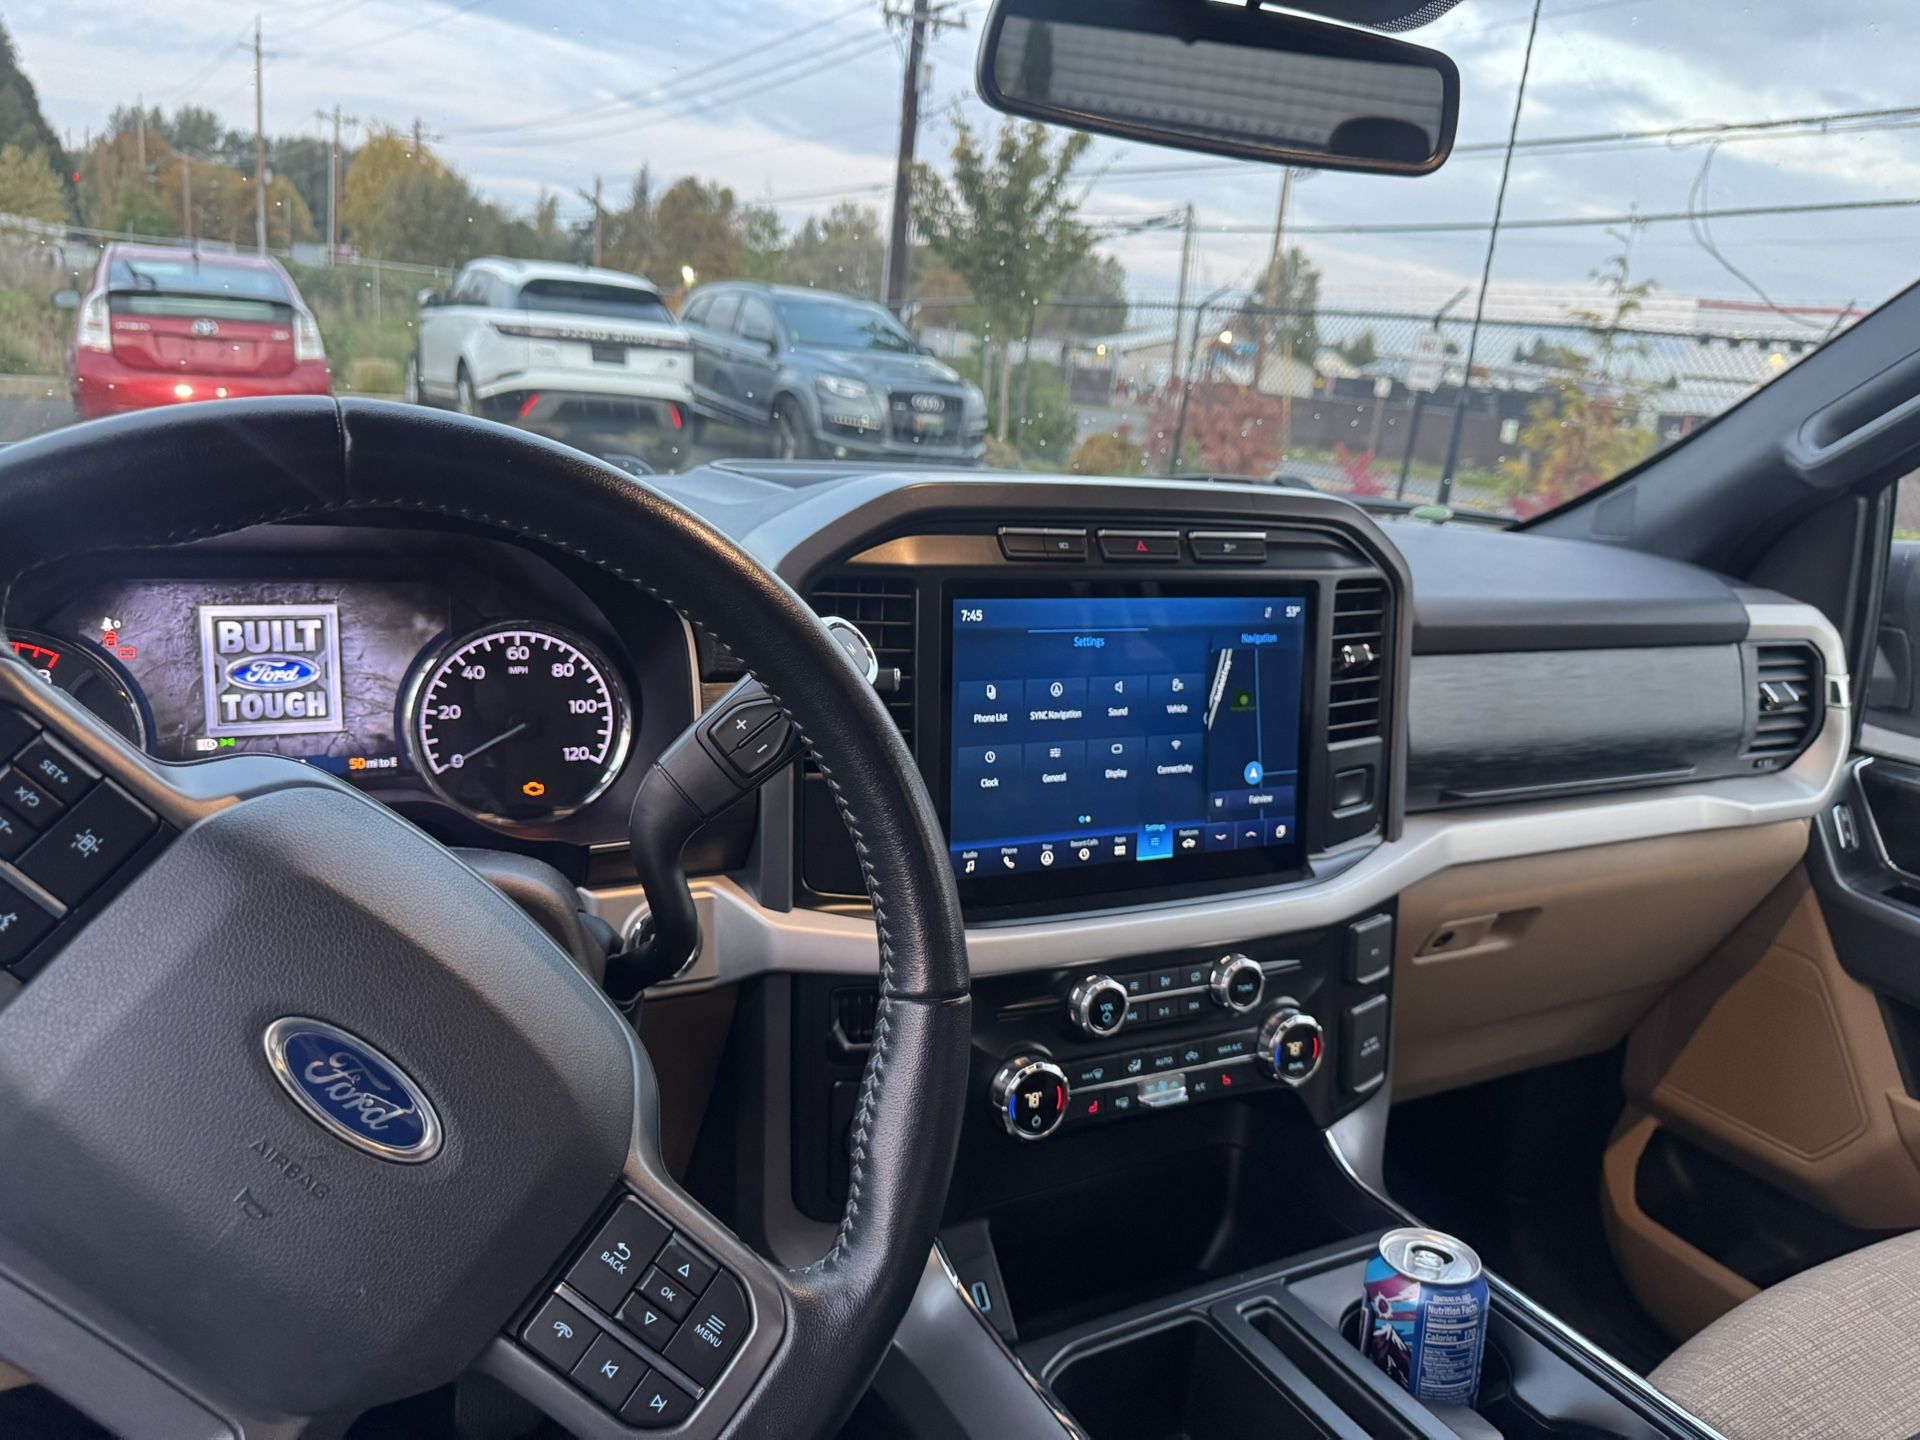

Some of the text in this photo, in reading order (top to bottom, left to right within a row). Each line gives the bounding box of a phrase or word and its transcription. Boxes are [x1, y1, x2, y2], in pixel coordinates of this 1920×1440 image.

[960, 609, 983, 622] 7:45
[217, 620, 321, 653] BUILT
[1073, 636, 1105, 648] Settings
[1241, 633, 1277, 645] Navigation
[506, 646, 530, 660] 60
[245, 661, 300, 682] Ford
[461, 665, 486, 680] 40
[508, 666, 529, 675] MPH
[551, 663, 575, 677] 80
[221, 691, 326, 721] TOUGH
[437, 705, 461, 719] 20
[568, 699, 598, 714] 100
[1108, 707, 1128, 717] Sound
[1166, 704, 1188, 714] Vehicle
[974, 712, 1008, 724] Phone List
[1029, 710, 1082, 721] SYNC Navigation
[562, 747, 590, 761] 120
[349, 757, 398, 770] 50 mi to E
[450, 754, 465, 768] 0
[40, 760, 69, 784] SET+
[1105, 769, 1128, 779] Display
[1157, 764, 1193, 775] Connectivity
[980, 778, 999, 788] Clock
[1042, 773, 1067, 783] General
[1145, 823, 1166, 832] Settings
[963, 851, 978, 859] Audio
[304, 1051, 415, 1130] Ford
[250, 1140, 329, 1199] AIRBAG
[600, 1251, 627, 1275] BACK
[660, 1286, 677, 1301] OK
[1427, 1303, 1478, 1316] Nutrition Facts
[694, 1324, 722, 1348] MENU
[1425, 1332, 1457, 1342] Calories
